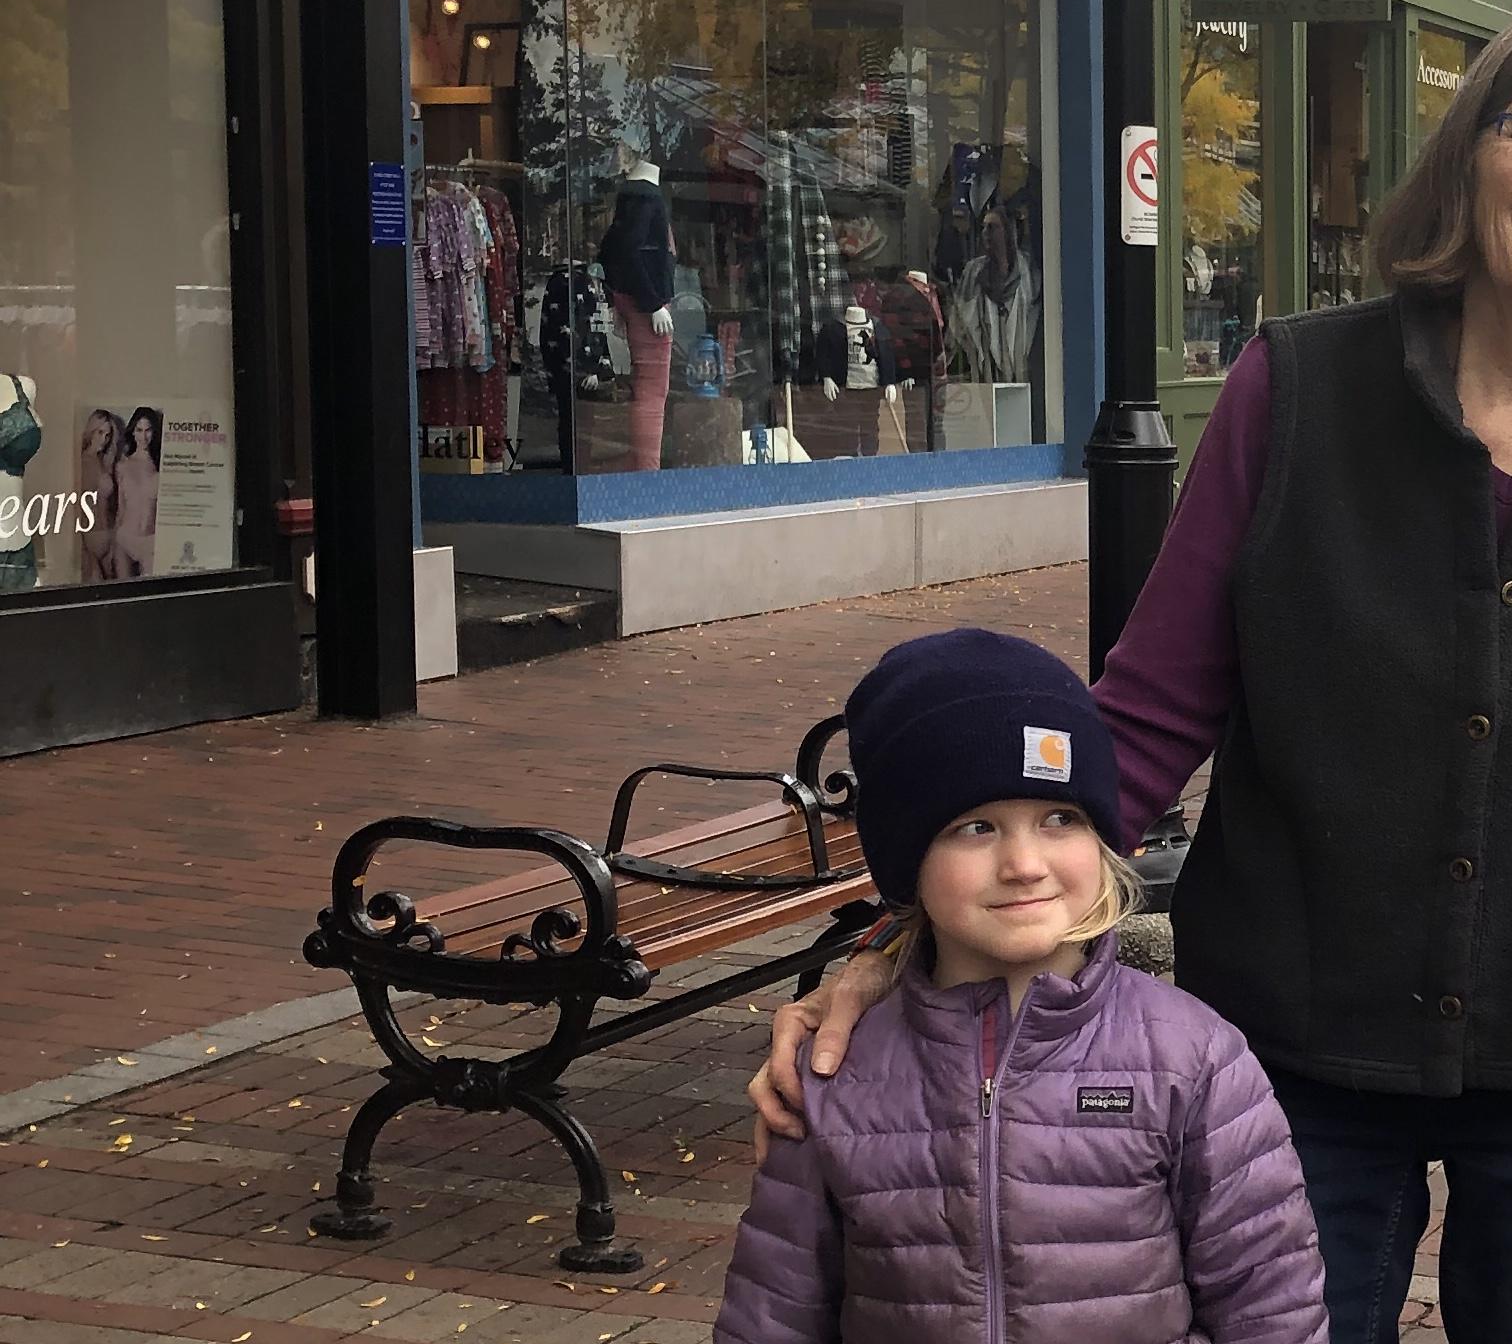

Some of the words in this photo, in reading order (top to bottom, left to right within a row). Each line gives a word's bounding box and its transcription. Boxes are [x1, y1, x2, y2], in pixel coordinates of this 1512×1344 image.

[1417, 55, 1465, 91] Accessori
[168, 422, 220, 433] TOGETHER
[1081, 1098, 1130, 1109] patagonia
